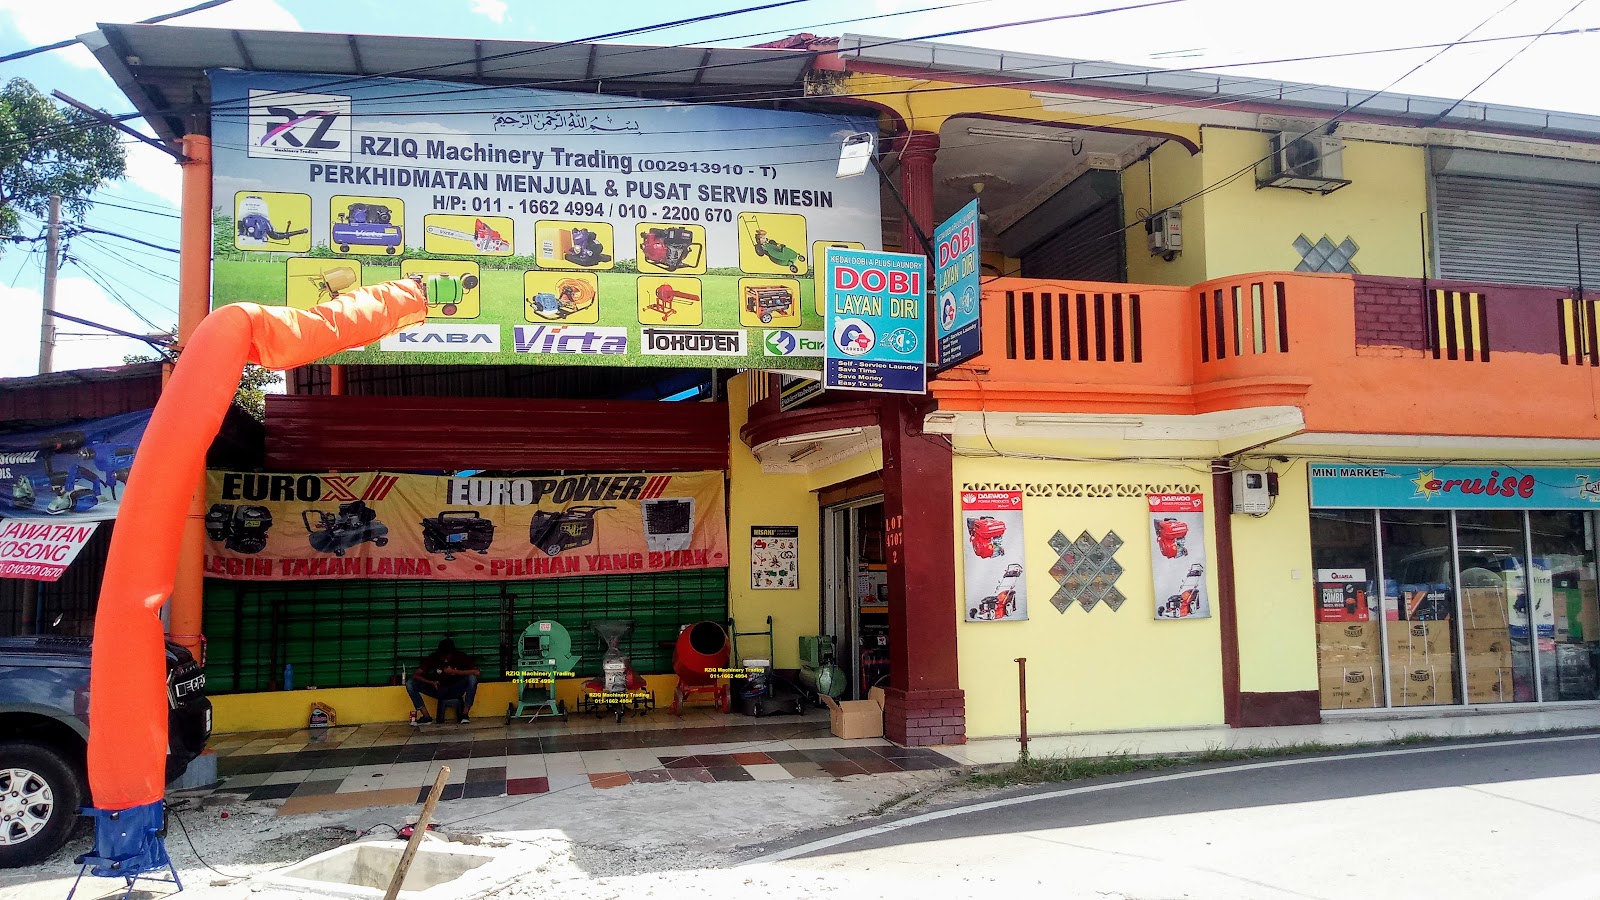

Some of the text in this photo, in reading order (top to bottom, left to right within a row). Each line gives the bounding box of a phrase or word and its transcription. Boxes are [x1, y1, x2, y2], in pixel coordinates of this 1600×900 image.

[360, 136, 418, 159] RZIQ
[426, 140, 544, 169] Machinery
[550, 147, 633, 174] Trading
[638, 159, 743, 176] (002913910
[759, 166, 777, 180] T)
[309, 164, 833, 208] PERKHIDMATAN MENJUAL & PUSAT SERVIS MESIN
[433, 195, 466, 211] H/P:
[472, 197, 502, 212] 011
[519, 200, 559, 216] 1662
[564, 202, 605, 217] 4994
[618, 204, 647, 219] 010
[662, 206, 700, 221] 2200
[704, 208, 733, 223] 670
[939, 220, 975, 269] DOBI
[831, 256, 850, 264] KEDAI
[892, 261, 922, 269] LAUNDRY
[940, 250, 975, 293] LAYAN DIRI
[835, 266, 919, 296] DOBI
[835, 293, 919, 319] LAYAN DIRI
[399, 332, 493, 344] KABA
[514, 326, 627, 354] Victa
[800, 338, 824, 350] Far
[860, 361, 887, 369] Service
[1340, 468, 1386, 477] MARKET
[0, 522, 92, 543] JAWATAN
[886, 515, 902, 531] LOT
[204, 555, 431, 576] LEBIH TAHAN LAMA
[490, 555, 583, 576] PILIHAN
[586, 553, 642, 572] YANG
[893, 551, 897, 563] 2
